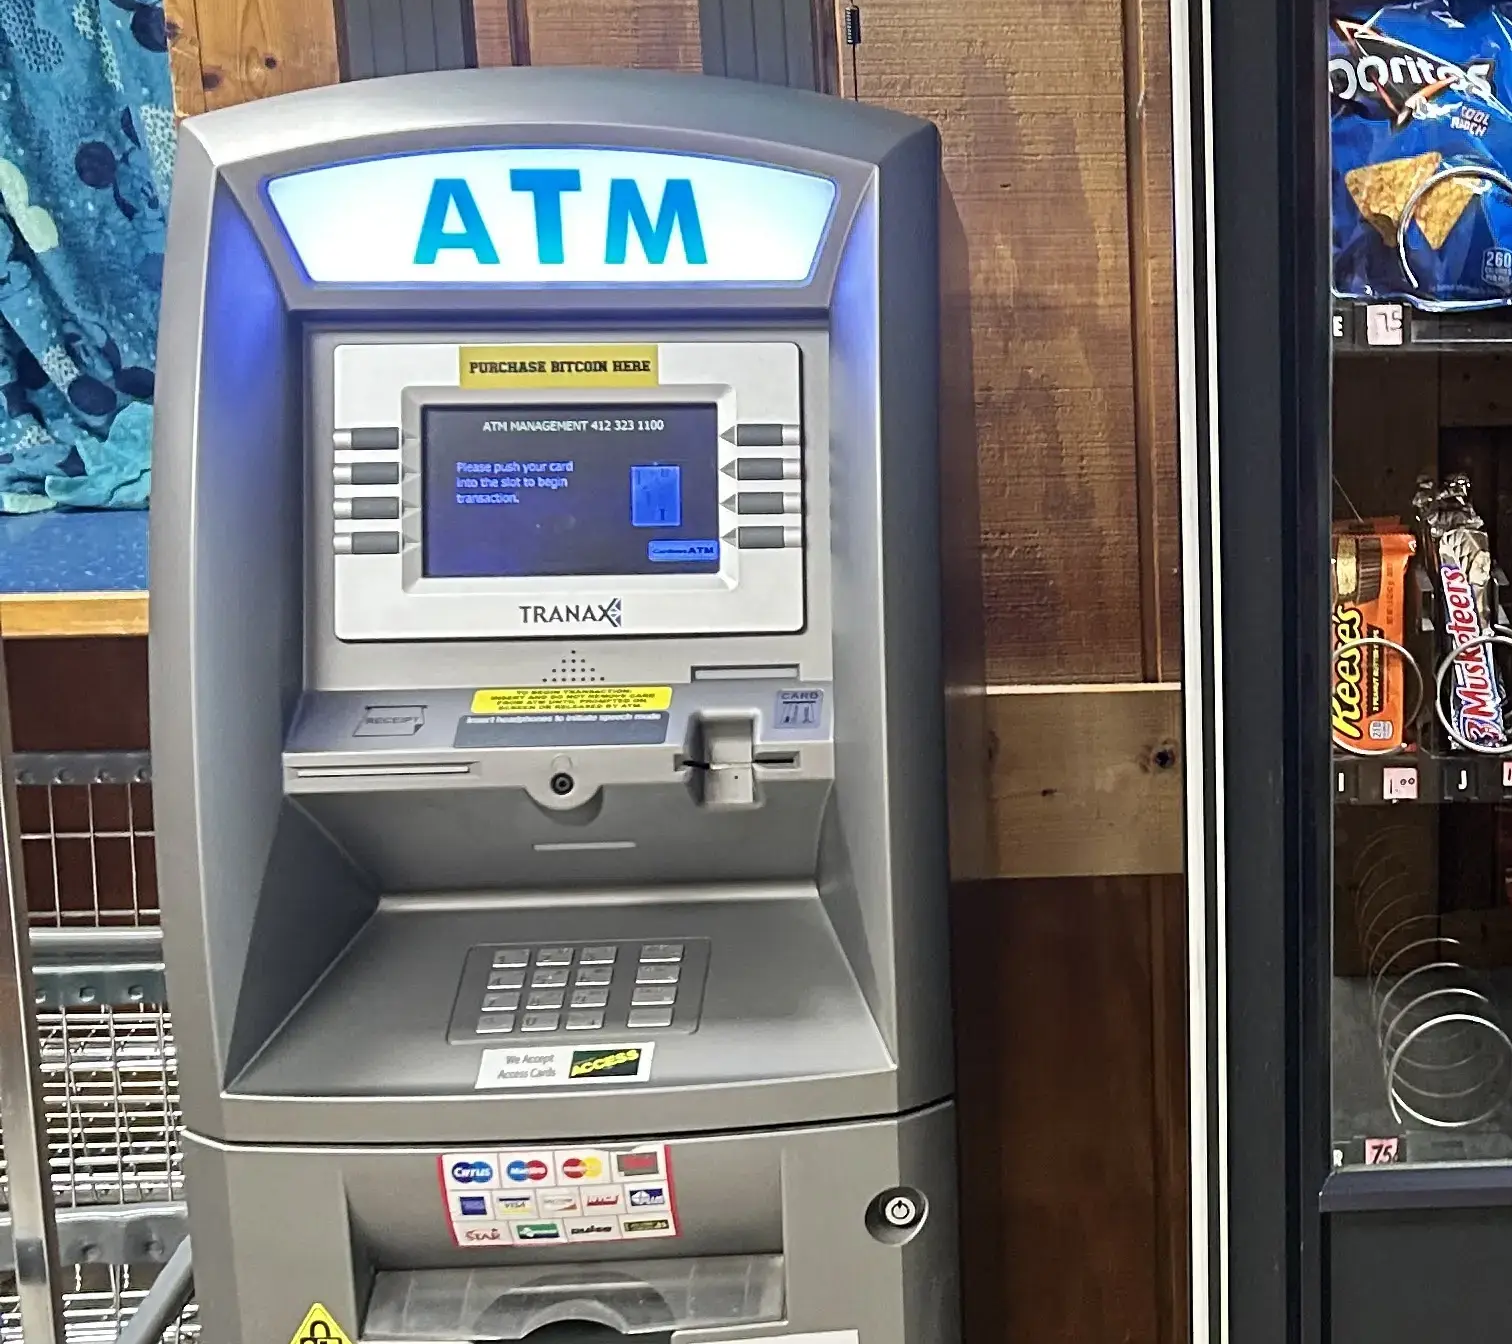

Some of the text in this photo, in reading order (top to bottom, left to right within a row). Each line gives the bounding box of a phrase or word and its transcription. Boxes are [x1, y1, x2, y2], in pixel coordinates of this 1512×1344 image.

[1460, 106, 1491, 125] COOL
[413, 169, 708, 265] ATM
[1486, 251, 1512, 268] 260
[1332, 315, 1343, 337] E
[469, 360, 651, 374] PURCHASE BITCOIN HERE
[483, 419, 664, 432] ATM MANAGEMENT 412 323 1100
[456, 460, 573, 474] Please push your card
[456, 475, 568, 490] into the slot to begin
[456, 492, 520, 504] transaction.
[519, 599, 618, 626] TRANAX
[1440, 564, 1496, 718] Musketeers
[1338, 772, 1345, 791] I
[1458, 769, 1467, 790] J
[524, 1054, 554, 1065] Accept
[571, 1048, 640, 1077] ACCESS
[497, 1067, 556, 1079] Access Cards
[1333, 1149, 1343, 1167] R
[453, 1166, 491, 1178] Cirrus
